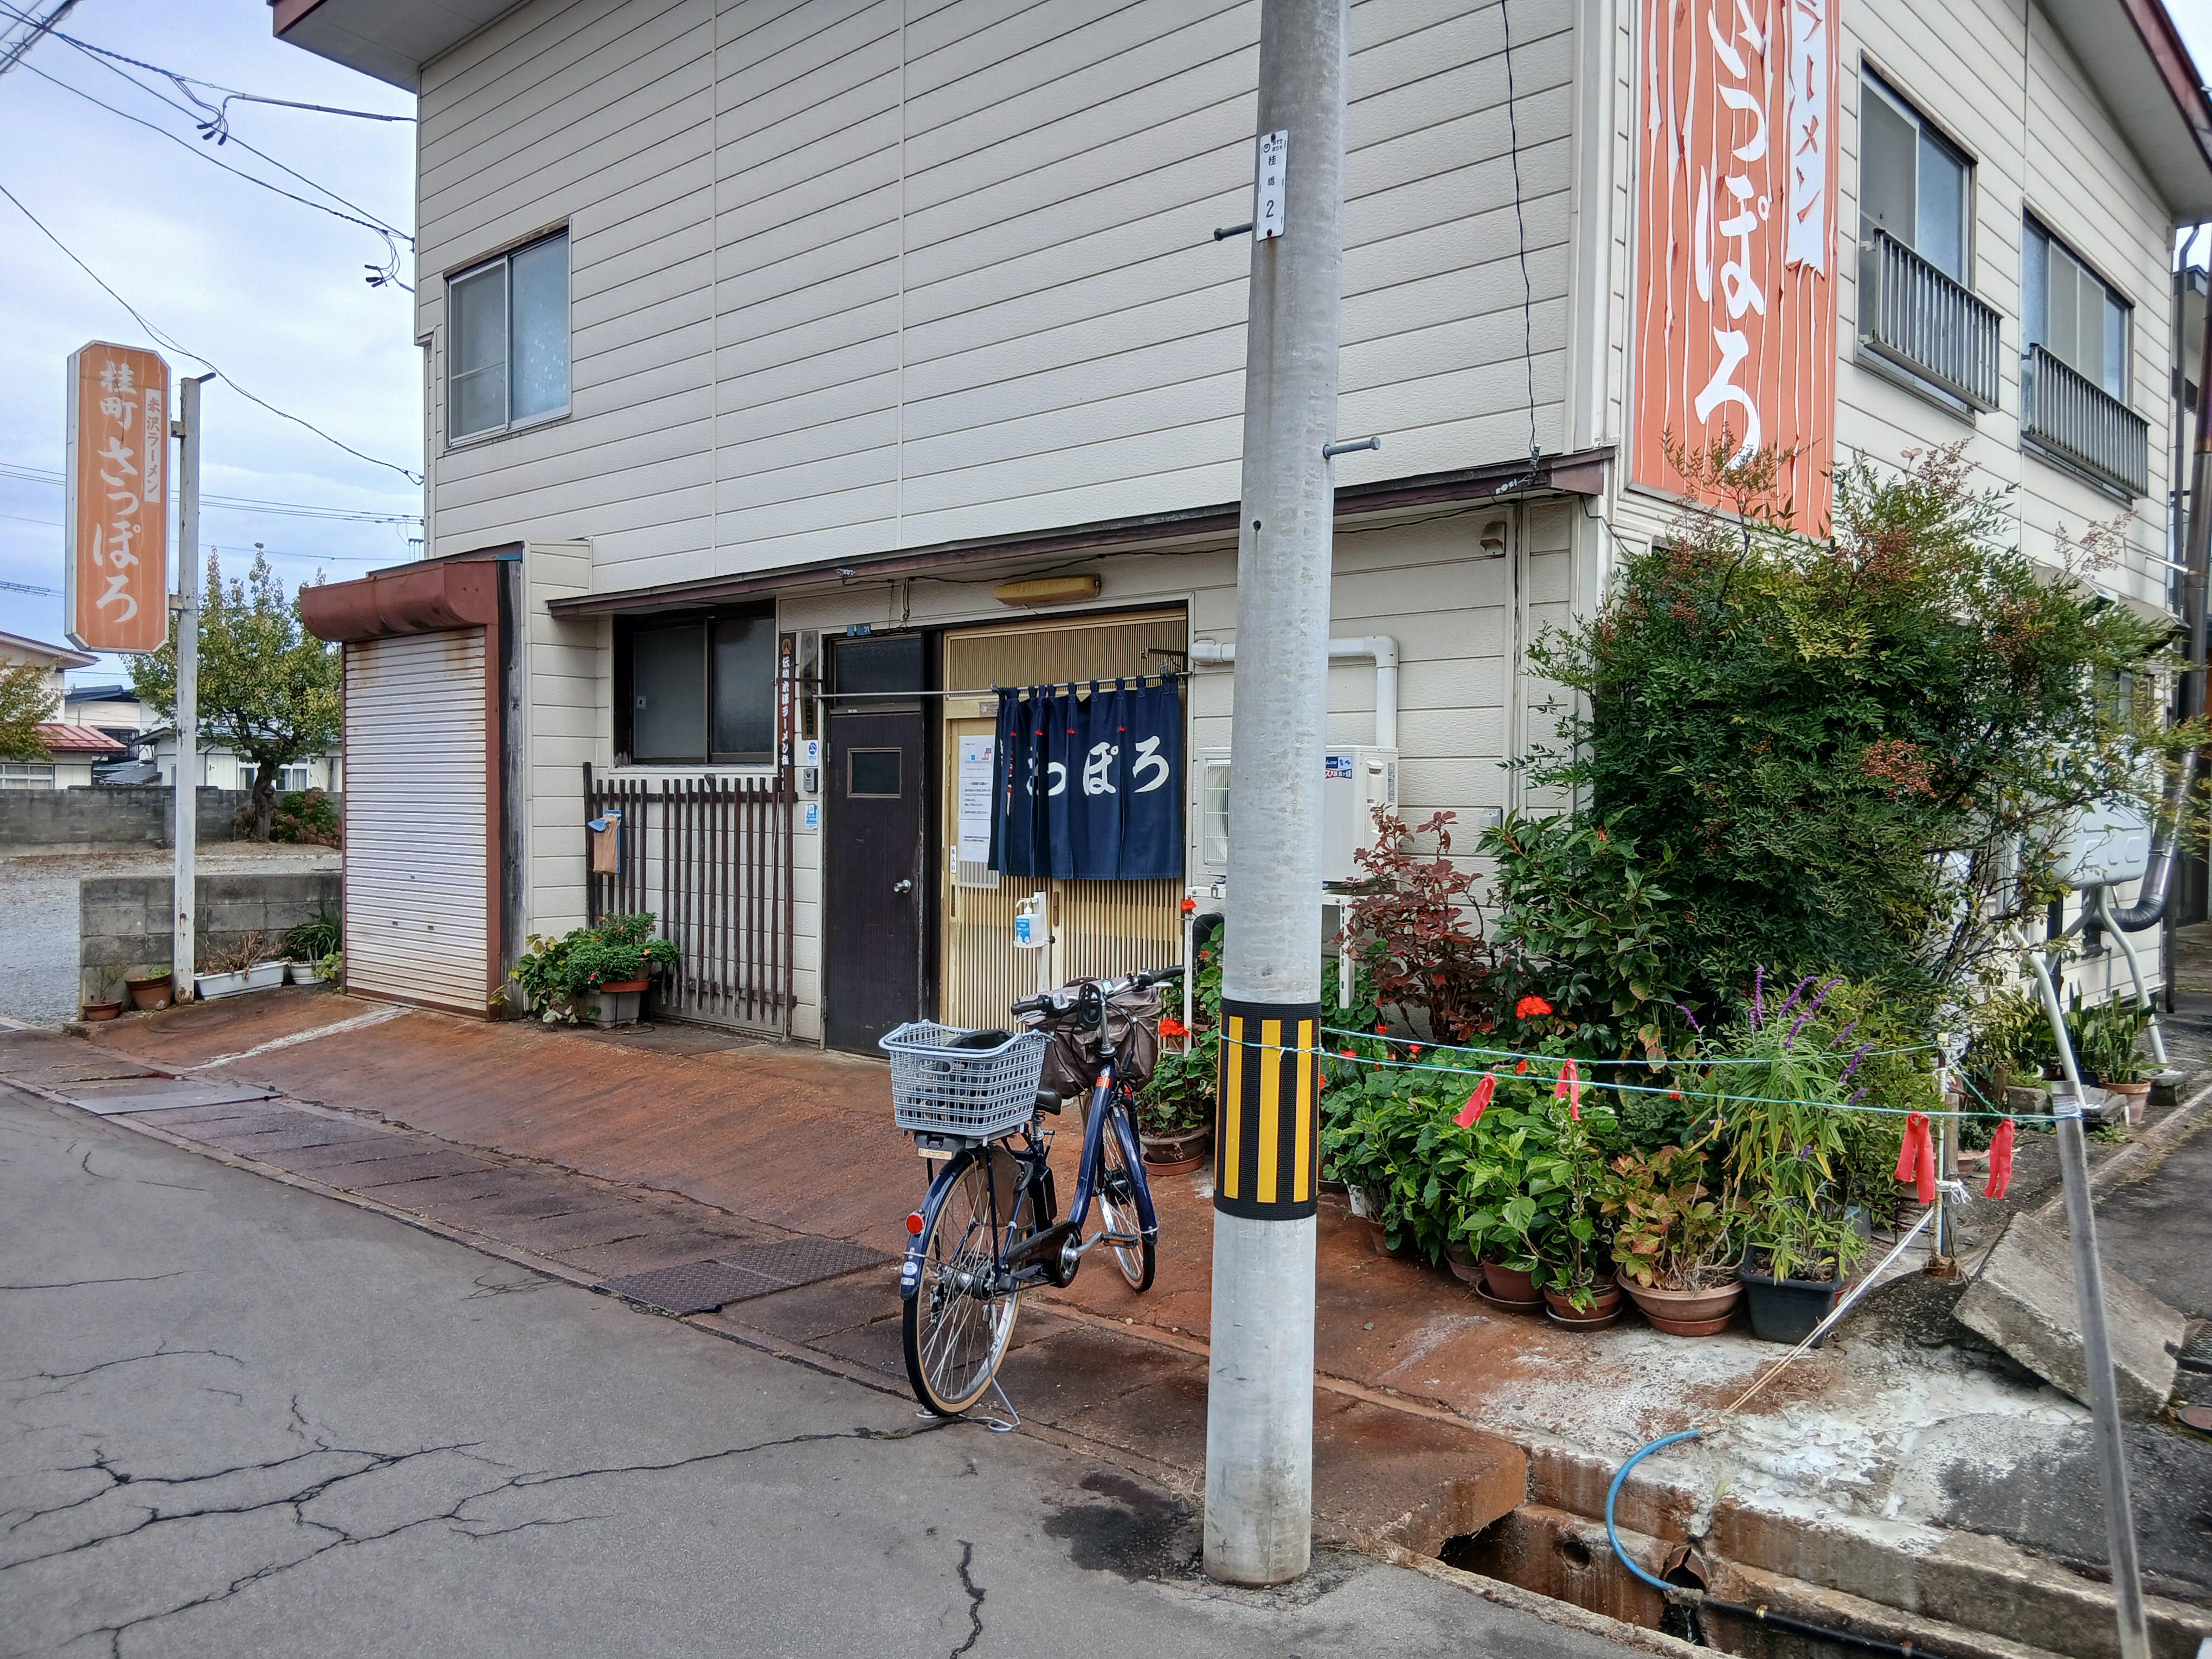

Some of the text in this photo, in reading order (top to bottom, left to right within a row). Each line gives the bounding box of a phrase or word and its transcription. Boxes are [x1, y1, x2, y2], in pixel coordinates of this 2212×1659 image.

[146, 397, 161, 494] 米沢ラーメン
